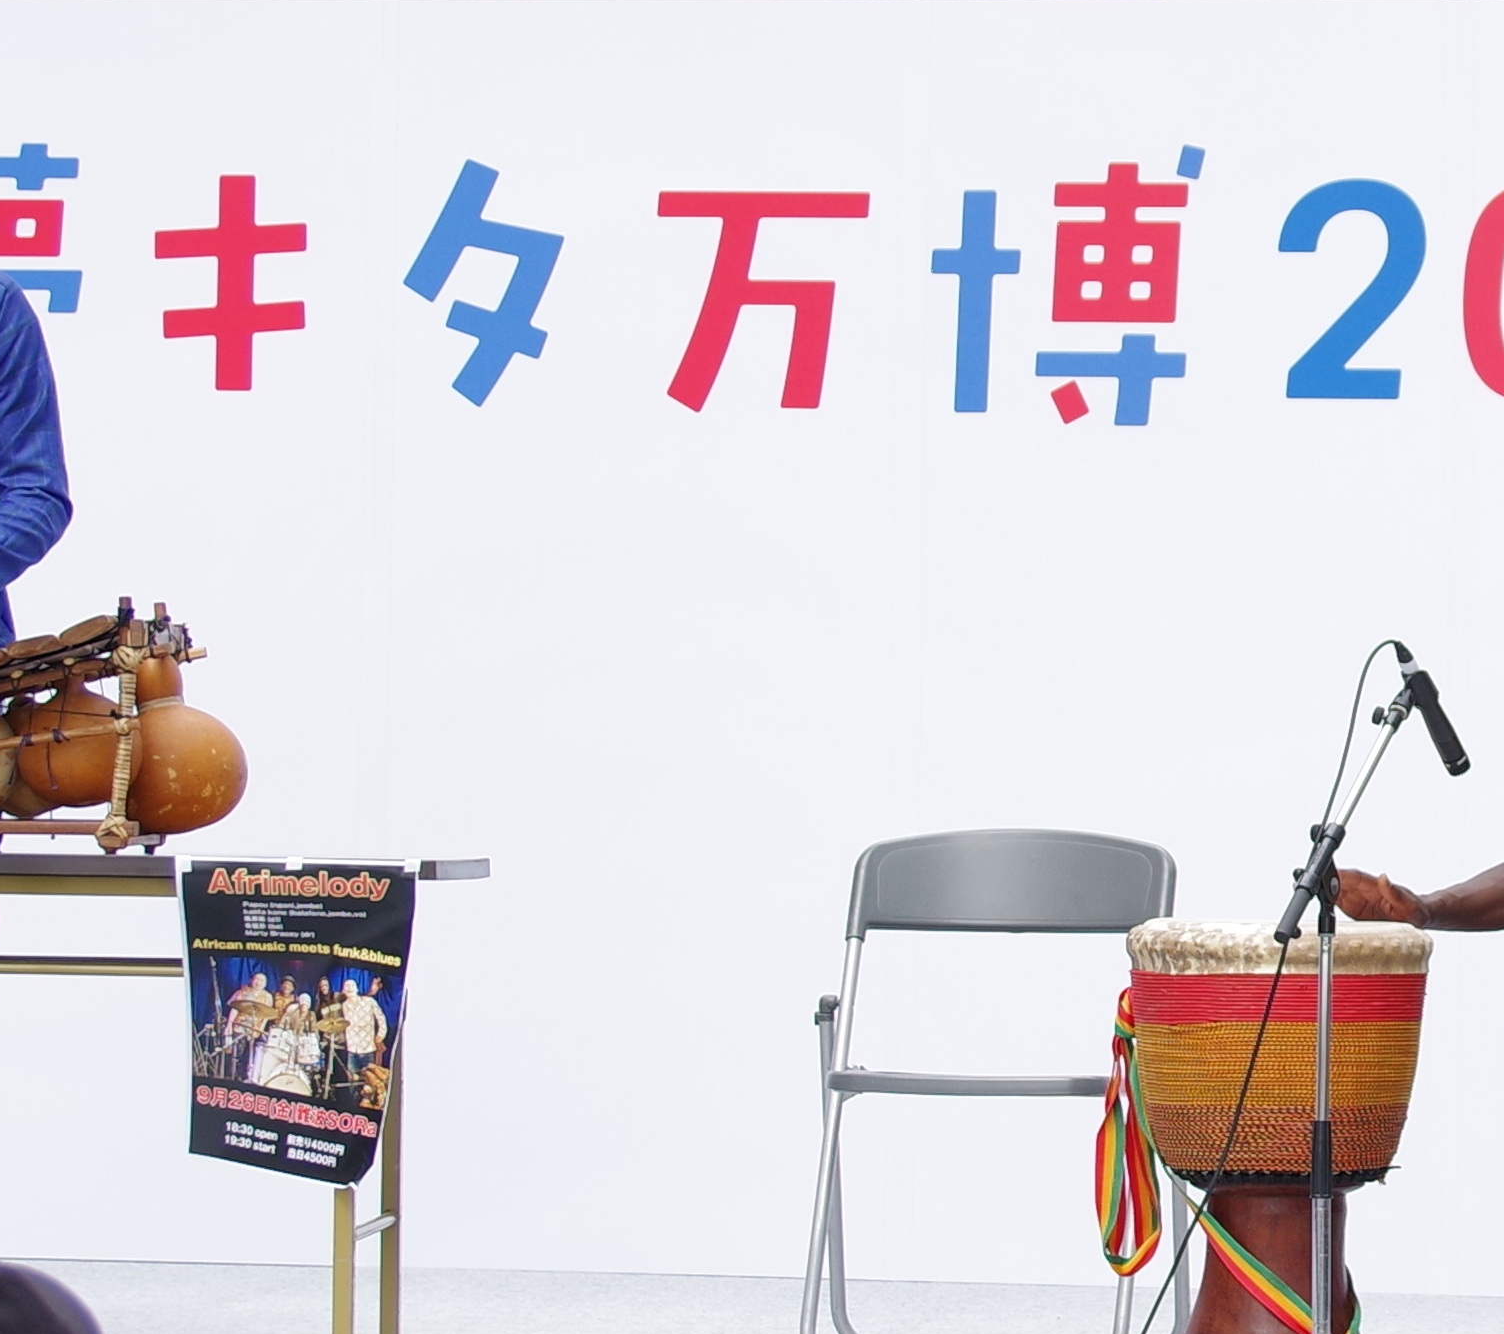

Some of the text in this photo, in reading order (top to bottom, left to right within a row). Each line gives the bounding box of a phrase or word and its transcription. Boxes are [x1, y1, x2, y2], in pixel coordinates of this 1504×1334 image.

[207, 867, 391, 902] Afrimelody
[192, 938, 403, 968] African music meets funk&blues
[225, 1120, 254, 1136] 18:30
[254, 1127, 279, 1142] open
[224, 1134, 252, 1149] 19:30
[252, 1141, 277, 1156] start
